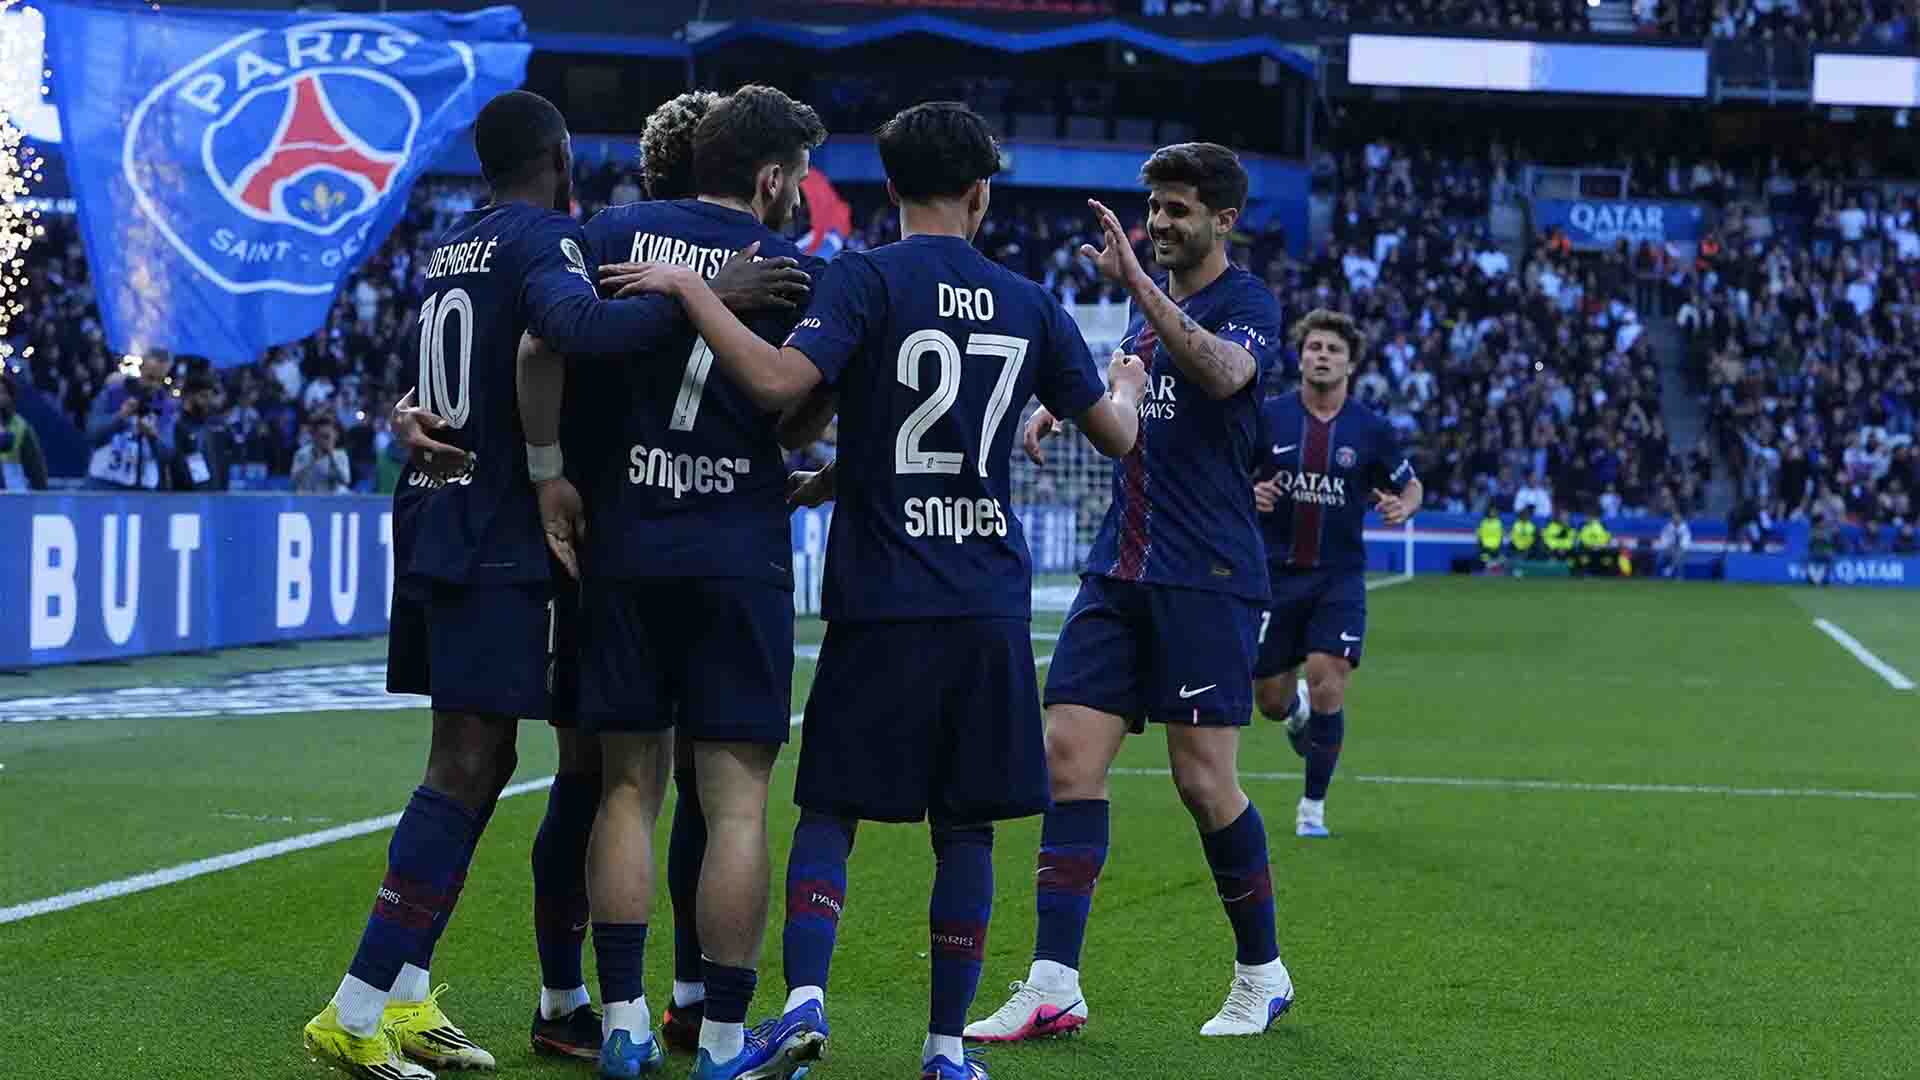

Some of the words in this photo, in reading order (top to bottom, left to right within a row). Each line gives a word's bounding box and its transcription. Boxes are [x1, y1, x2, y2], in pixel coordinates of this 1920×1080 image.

[177, 32, 405, 111] PARIS
[1570, 203, 1664, 232] QATAR
[209, 228, 292, 264] SAINT
[937, 277, 994, 321] DRO
[418, 287, 474, 429] 10
[896, 329, 1030, 478] 27
[629, 444, 735, 499] snipes
[1276, 470, 1345, 495] QATAR
[904, 496, 1008, 544] snipes
[30, 513, 200, 650] BUT
